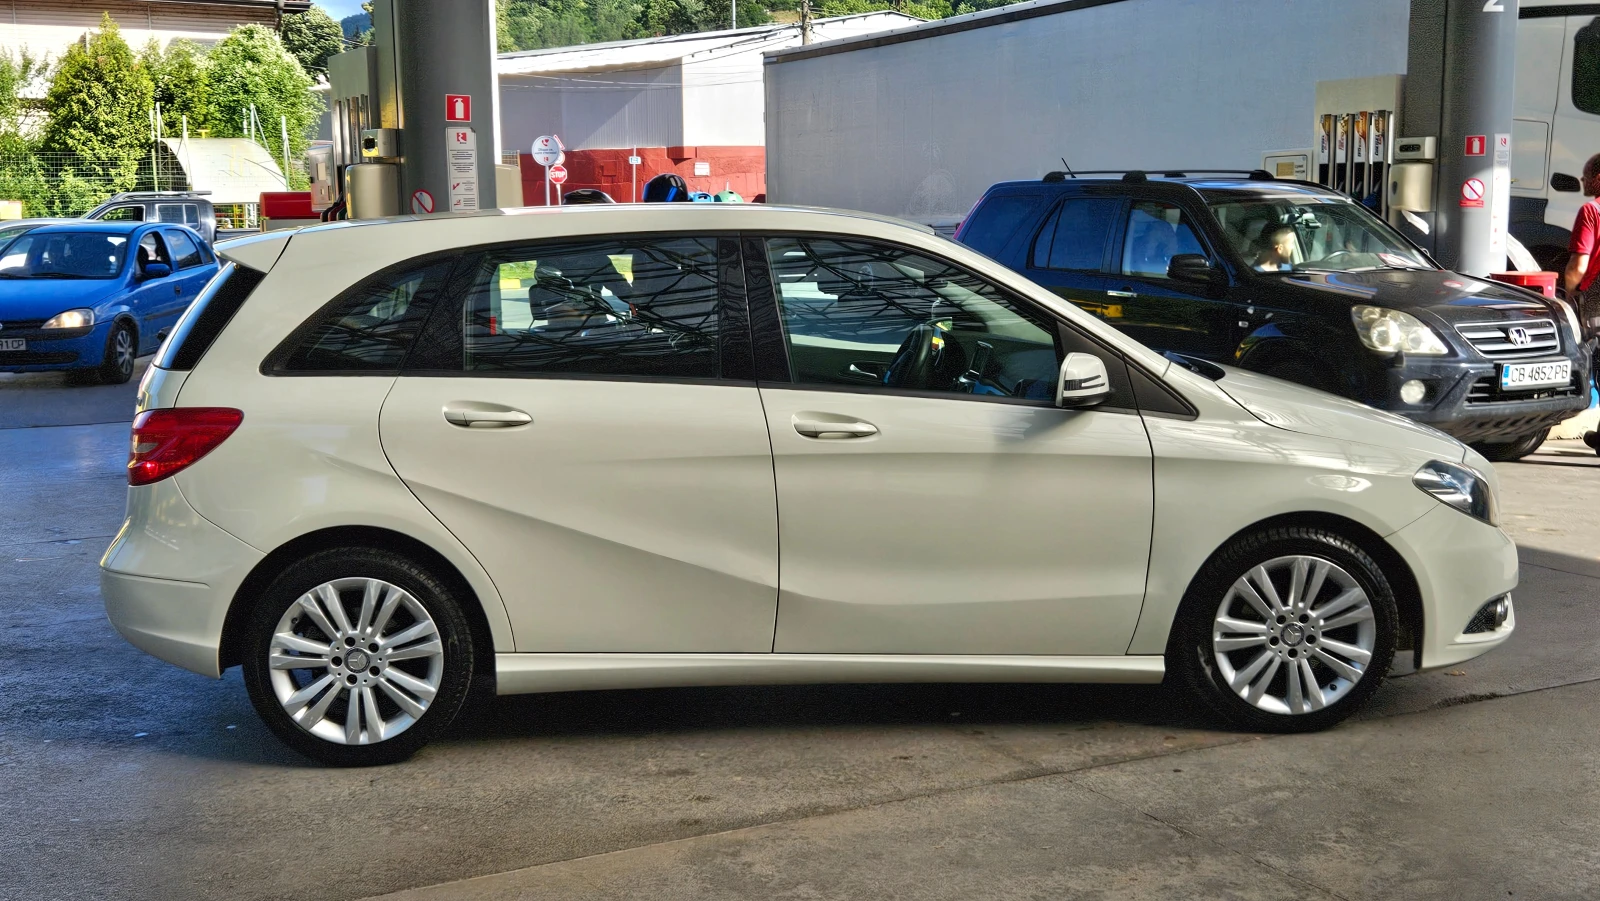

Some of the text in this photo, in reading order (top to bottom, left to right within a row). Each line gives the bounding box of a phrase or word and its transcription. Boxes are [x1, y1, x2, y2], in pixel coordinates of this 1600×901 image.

[1511, 364, 1568, 383] CB 4852 PB
